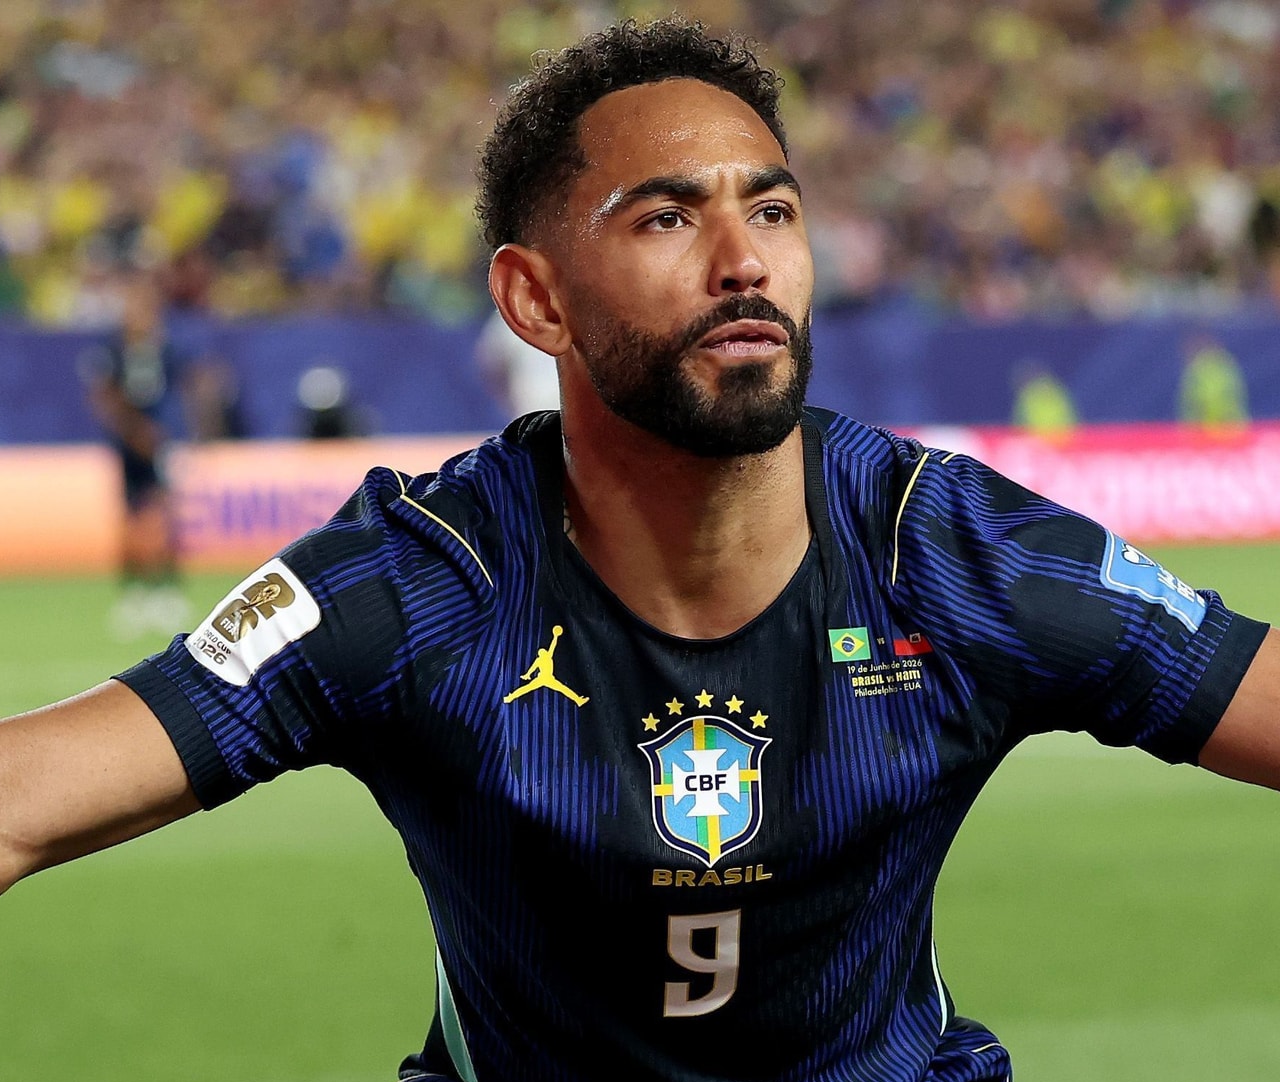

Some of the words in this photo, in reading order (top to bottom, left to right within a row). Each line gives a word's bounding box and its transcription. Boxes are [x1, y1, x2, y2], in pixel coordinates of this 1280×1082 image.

[216, 641, 231, 654] CUP
[847, 666, 856, 674] 19
[858, 665, 867, 673] de
[891, 661, 900, 669] de
[902, 659, 922, 668] 2026
[903, 682, 922, 692] EUA
[684, 774, 727, 792] CBF
[652, 864, 773, 887] BRASIL
[663, 908, 742, 1018] 9
